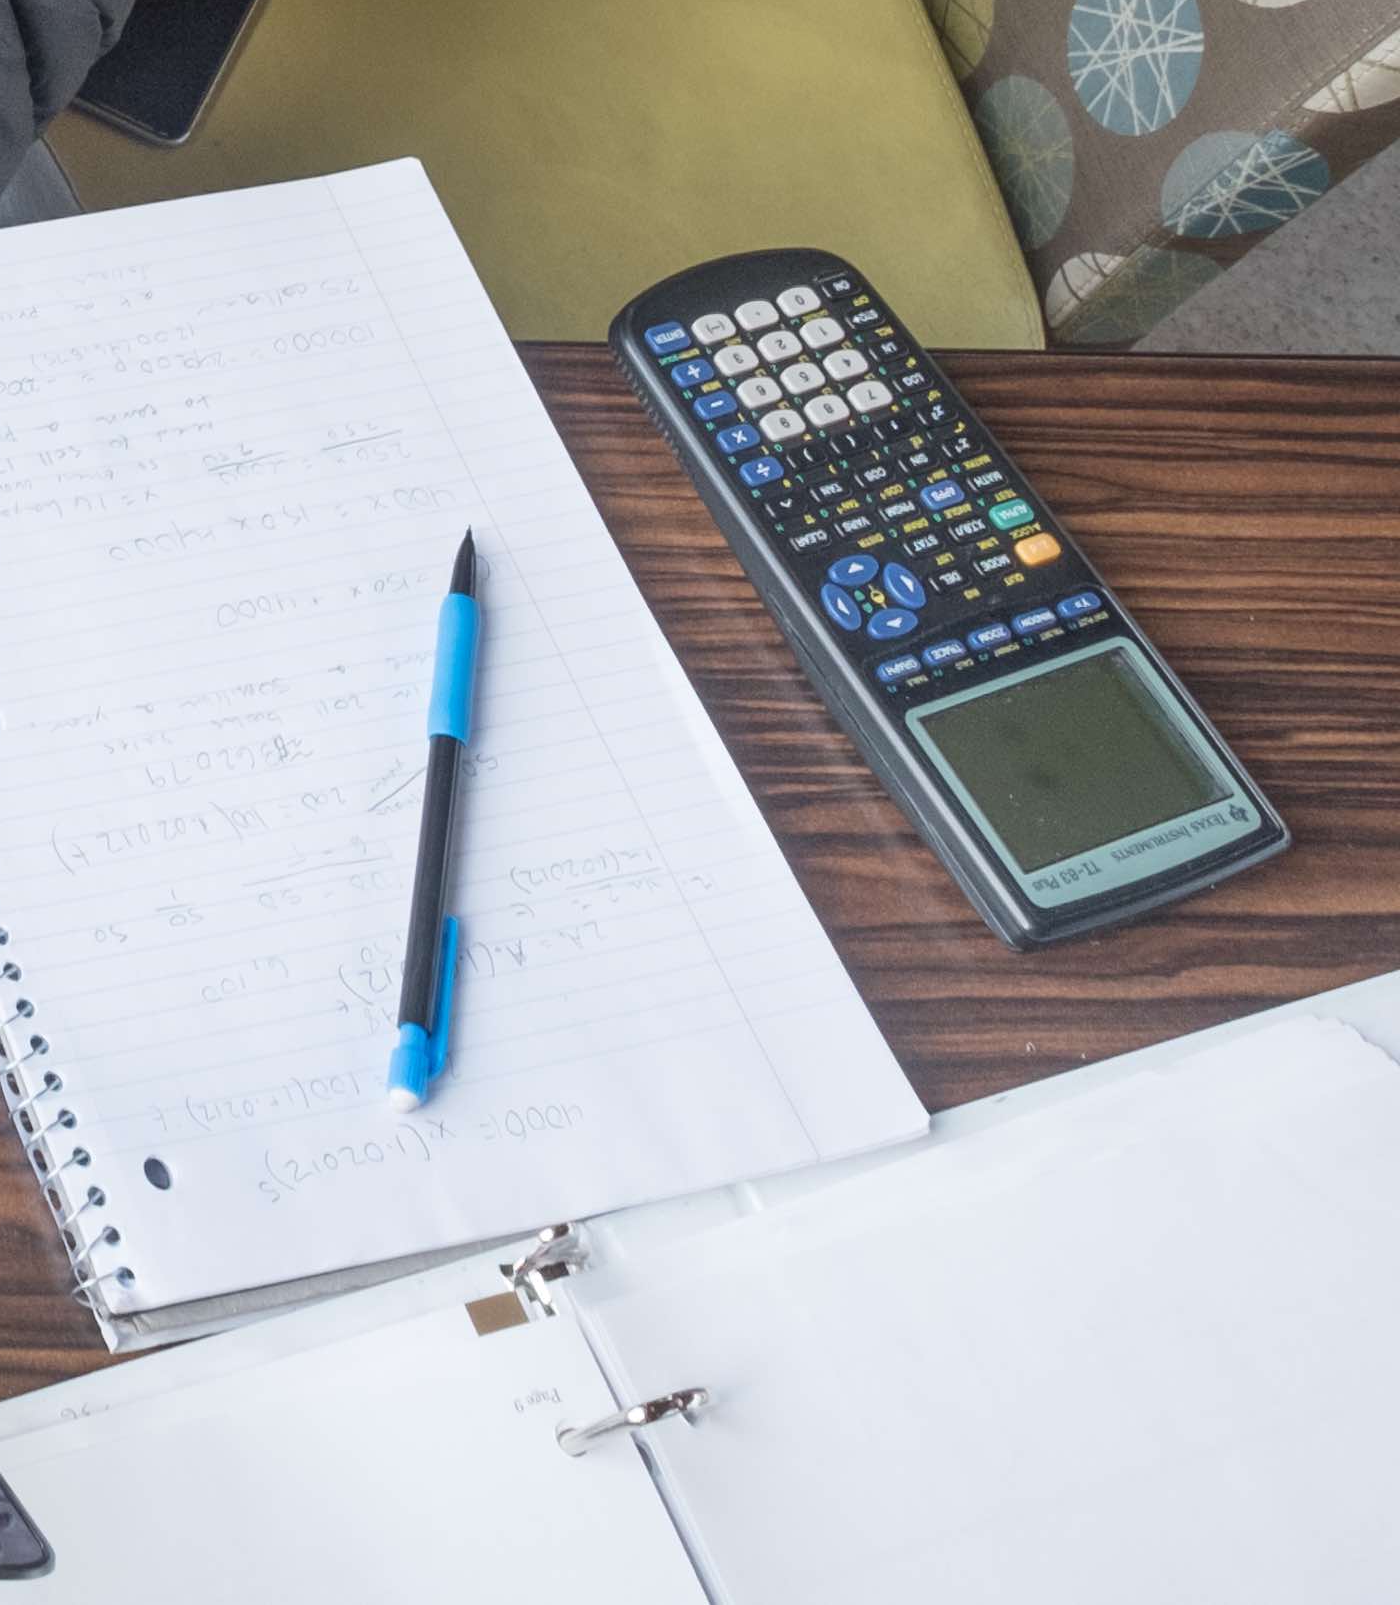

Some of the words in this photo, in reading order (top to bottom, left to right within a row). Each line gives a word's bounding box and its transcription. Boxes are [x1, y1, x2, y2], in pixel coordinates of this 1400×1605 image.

[795, 295, 805, 305] 0
[818, 326, 829, 336] 1
[775, 339, 786, 350] 2
[733, 354, 744, 364] 3
[840, 358, 851, 367] 4
[799, 373, 810, 383] 5
[756, 385, 766, 395] 6
[867, 390, 878, 400] 7
[824, 403, 833, 414] 8
[780, 417, 791, 429] 9
[797, 530, 828, 547] CLEAR
[939, 570, 962, 585] DEL
[1111, 827, 1193, 863] INSTRUMENTS
[1063, 860, 1104, 884] TI-83
[526, 1384, 563, 1410] Page
[511, 1395, 523, 1412] 9
